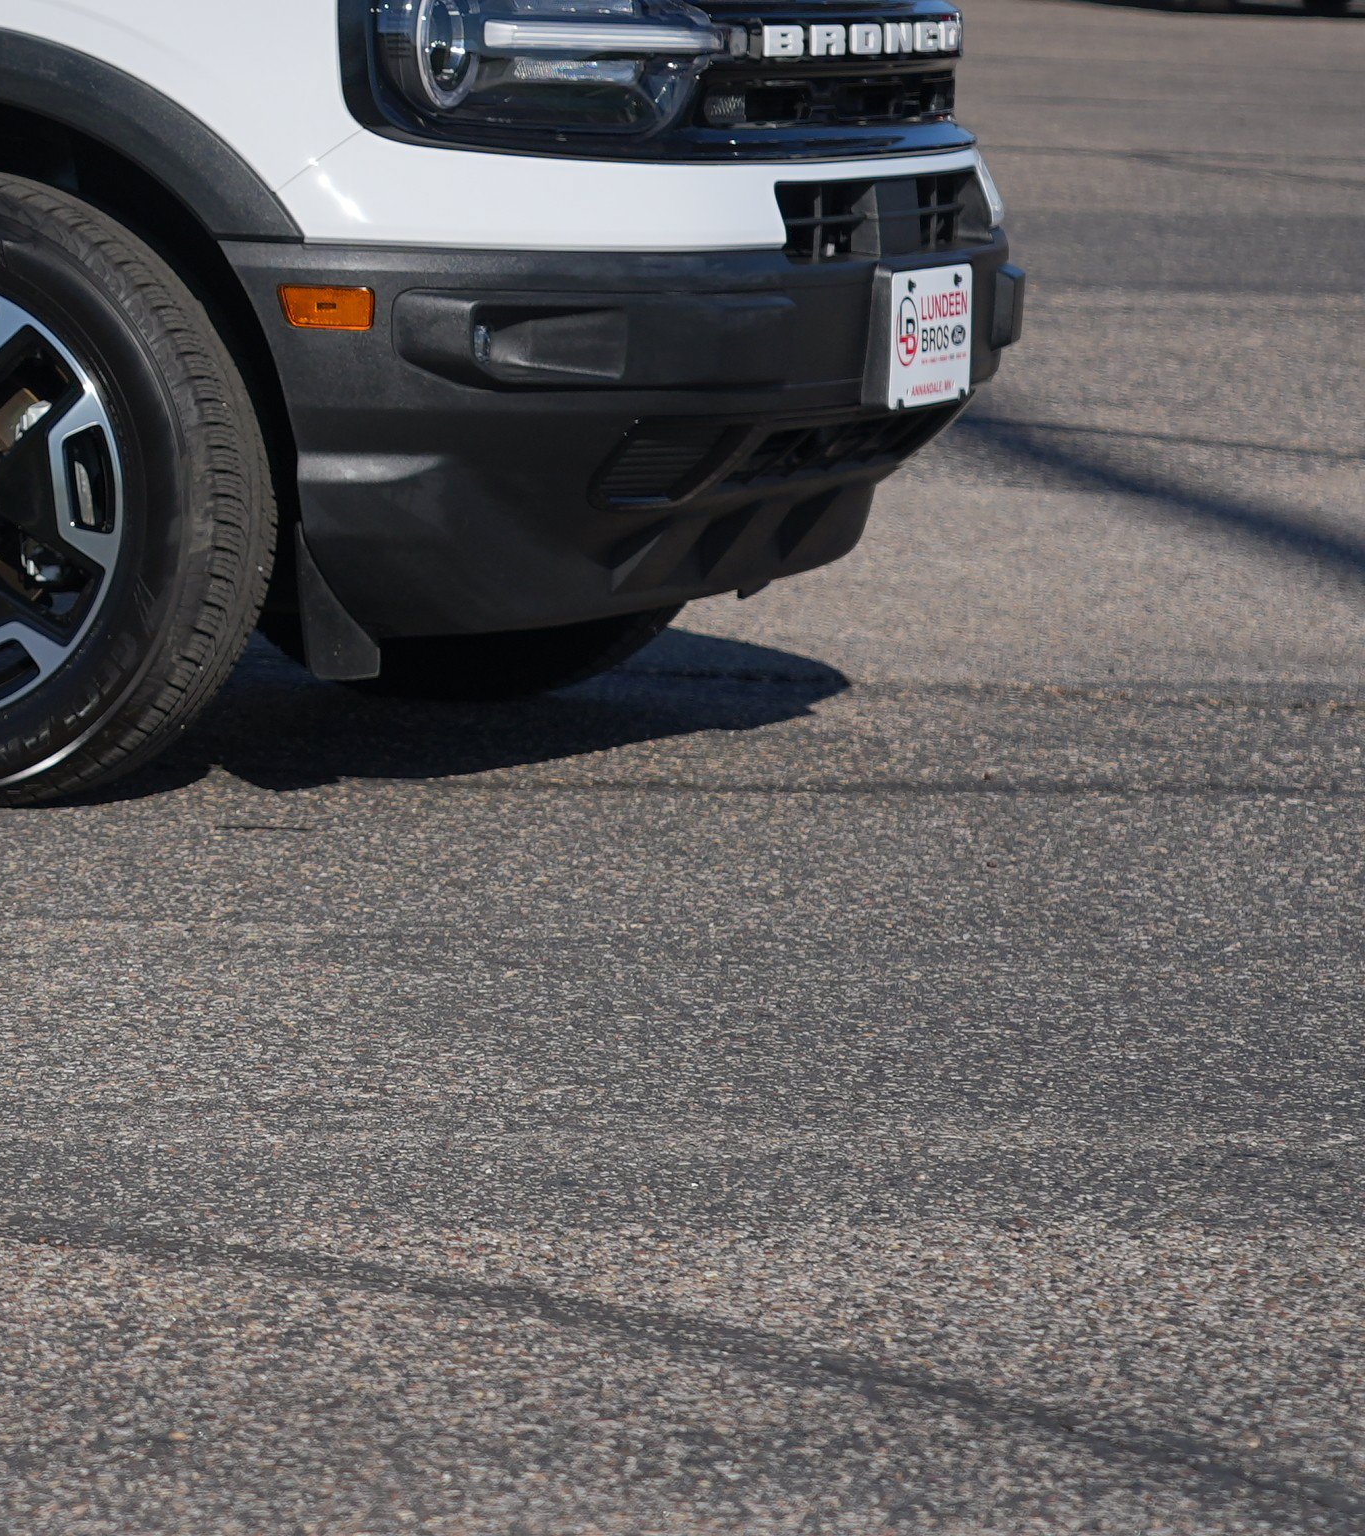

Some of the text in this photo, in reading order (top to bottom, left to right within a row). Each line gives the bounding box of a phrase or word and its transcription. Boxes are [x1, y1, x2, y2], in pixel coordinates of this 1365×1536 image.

[763, 21, 959, 57] BRONCO
[920, 290, 968, 321] LUNDEEN
[921, 324, 949, 352] BROS
